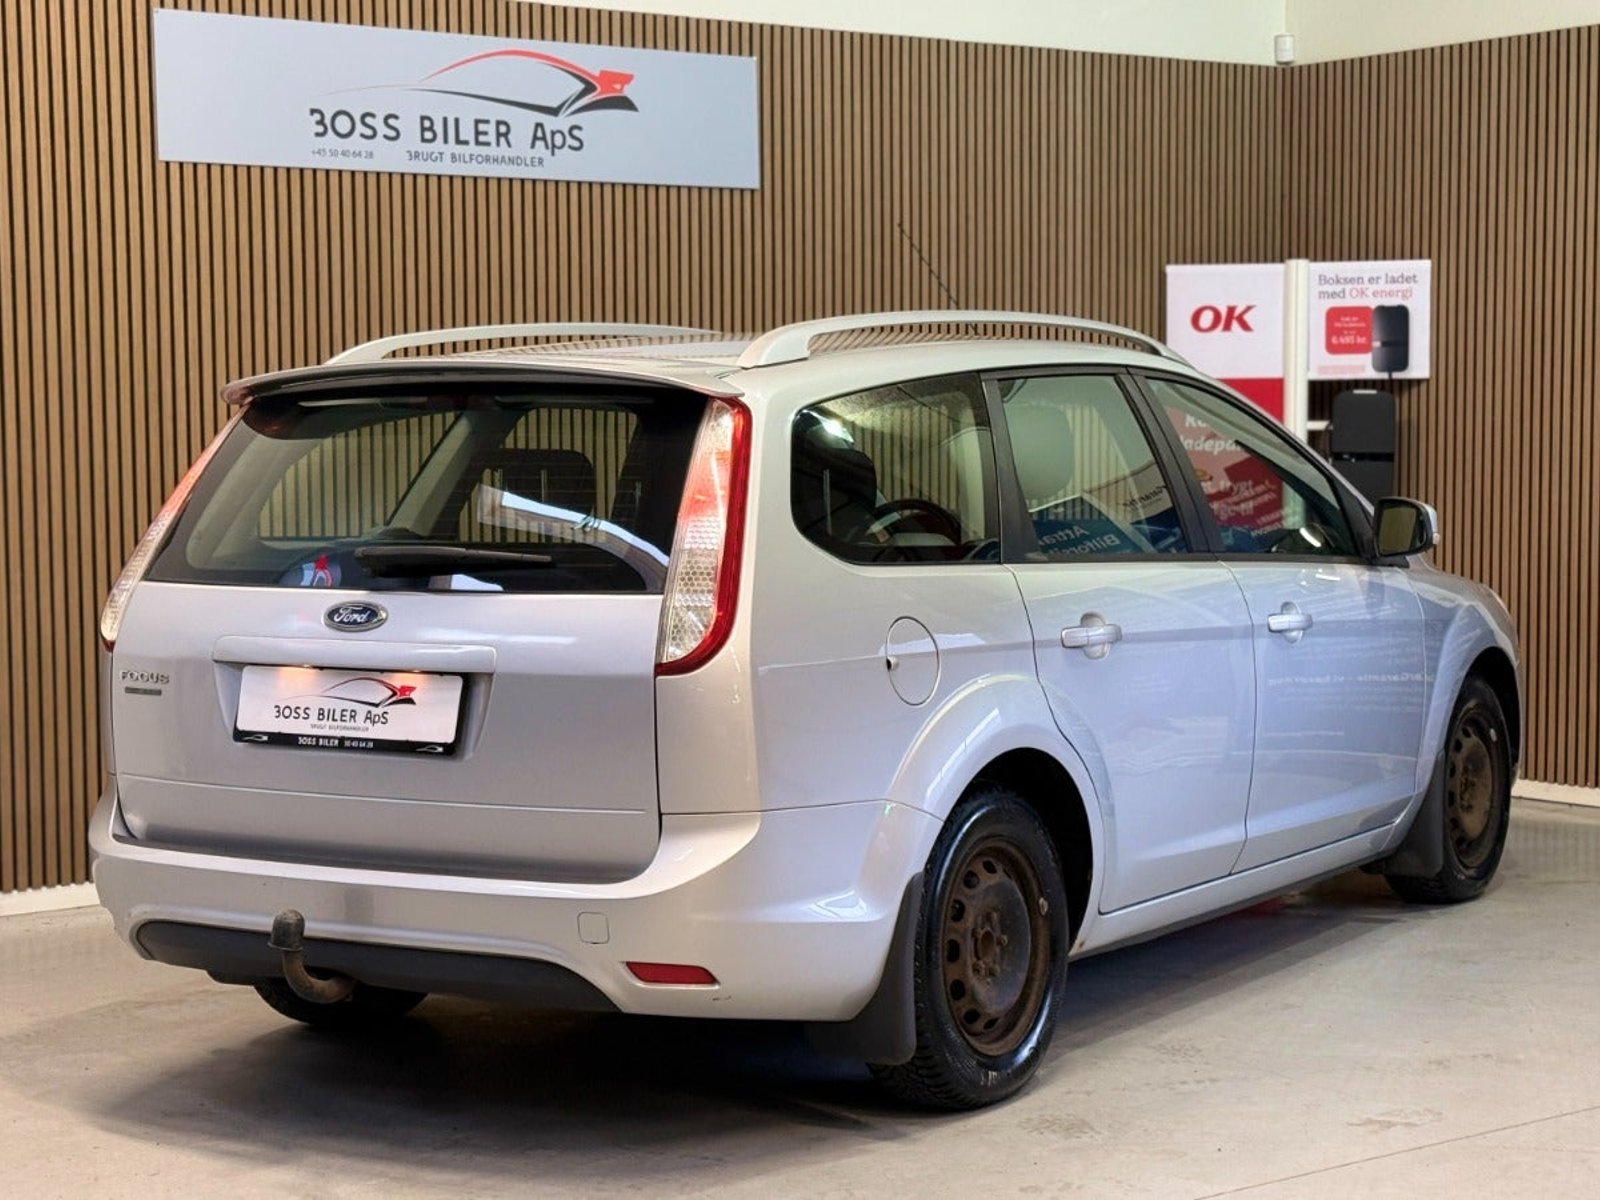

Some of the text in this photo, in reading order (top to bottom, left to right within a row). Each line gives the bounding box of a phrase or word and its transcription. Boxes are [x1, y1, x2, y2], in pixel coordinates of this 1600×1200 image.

[419, 115, 513, 148] BILER
[529, 121, 584, 156] ApS
[450, 152, 545, 168] BILFORHANDLER
[1318, 272, 1418, 286] Boksen er ladet
[1318, 286, 1413, 301] med OK energi
[1190, 304, 1257, 333] OK
[332, 606, 371, 626] Ford
[120, 669, 170, 685] FOCUS
[317, 707, 358, 724] BILER
[364, 710, 389, 727] ApS
[318, 738, 339, 748] BILER
